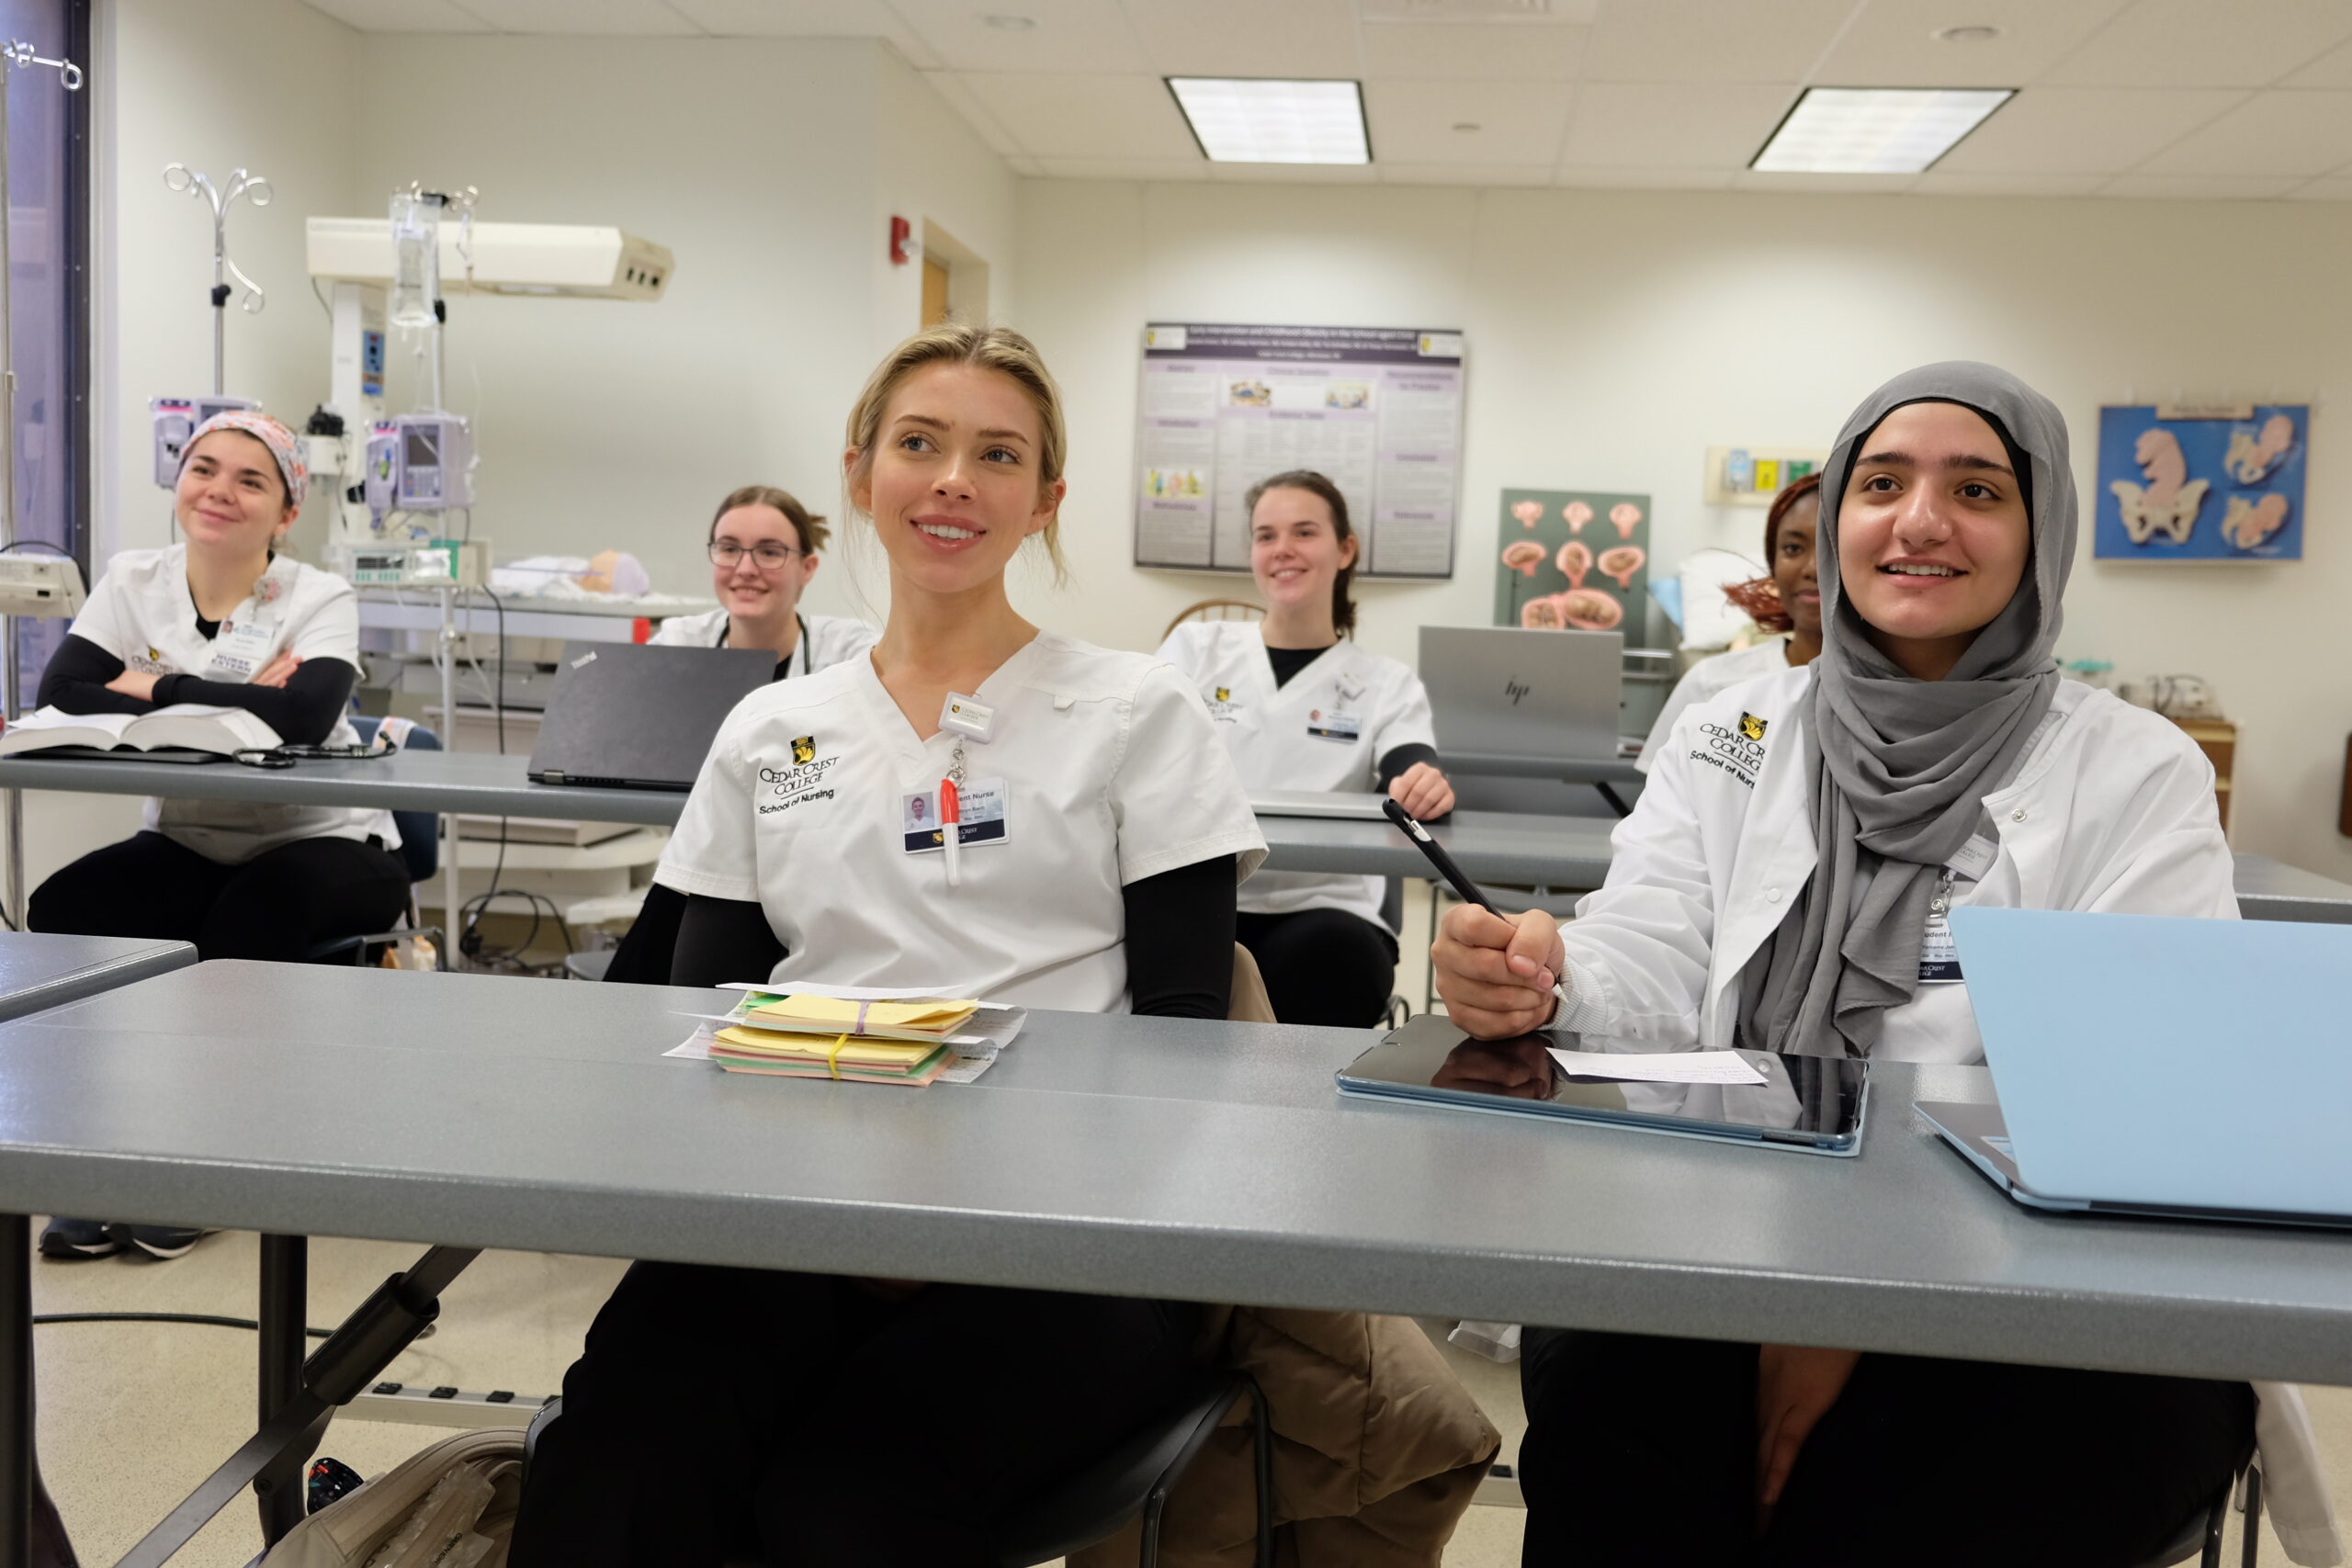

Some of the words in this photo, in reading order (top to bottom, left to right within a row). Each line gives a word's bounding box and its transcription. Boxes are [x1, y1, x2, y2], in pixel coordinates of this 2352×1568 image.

[211, 659, 252, 672] EXTERN
[216, 654, 251, 666] NURSE
[1505, 675, 1530, 706] hp
[1700, 723, 1745, 750] CEDAR
[1690, 750, 1724, 768] School
[1724, 765, 1736, 774] of
[1710, 738, 1761, 771] COLLEG
[759, 768, 802, 784] CEDAR
[803, 756, 840, 775] CREST
[775, 772, 823, 795] COLLEGE
[972, 791, 994, 799] Nurse
[759, 800, 790, 815] School
[790, 796, 800, 807] of
[800, 789, 835, 803] Nursing
[433, 1532, 463, 1566] GARNIER
